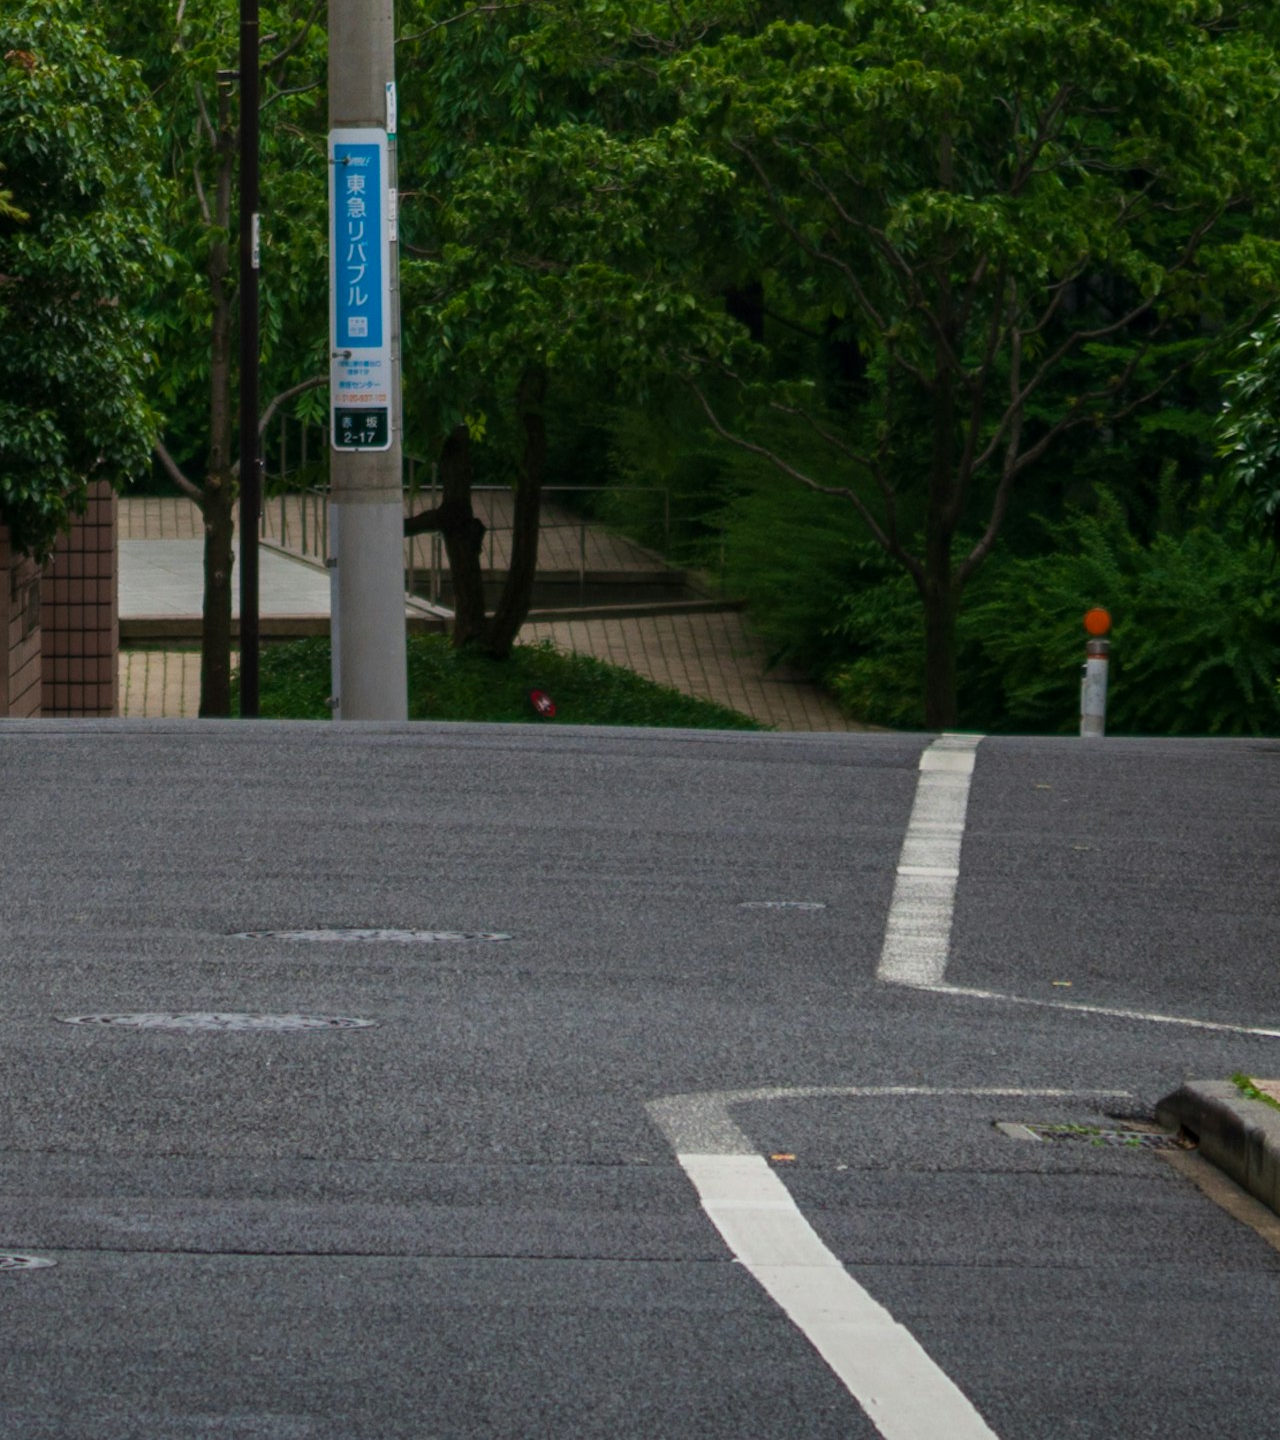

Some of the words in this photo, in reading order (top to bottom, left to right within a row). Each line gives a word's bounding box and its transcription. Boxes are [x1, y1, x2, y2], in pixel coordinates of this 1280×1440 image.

[346, 174, 369, 307] 東急リバブル
[342, 416, 378, 429] 赤坂
[343, 431, 376, 444] 2-17
